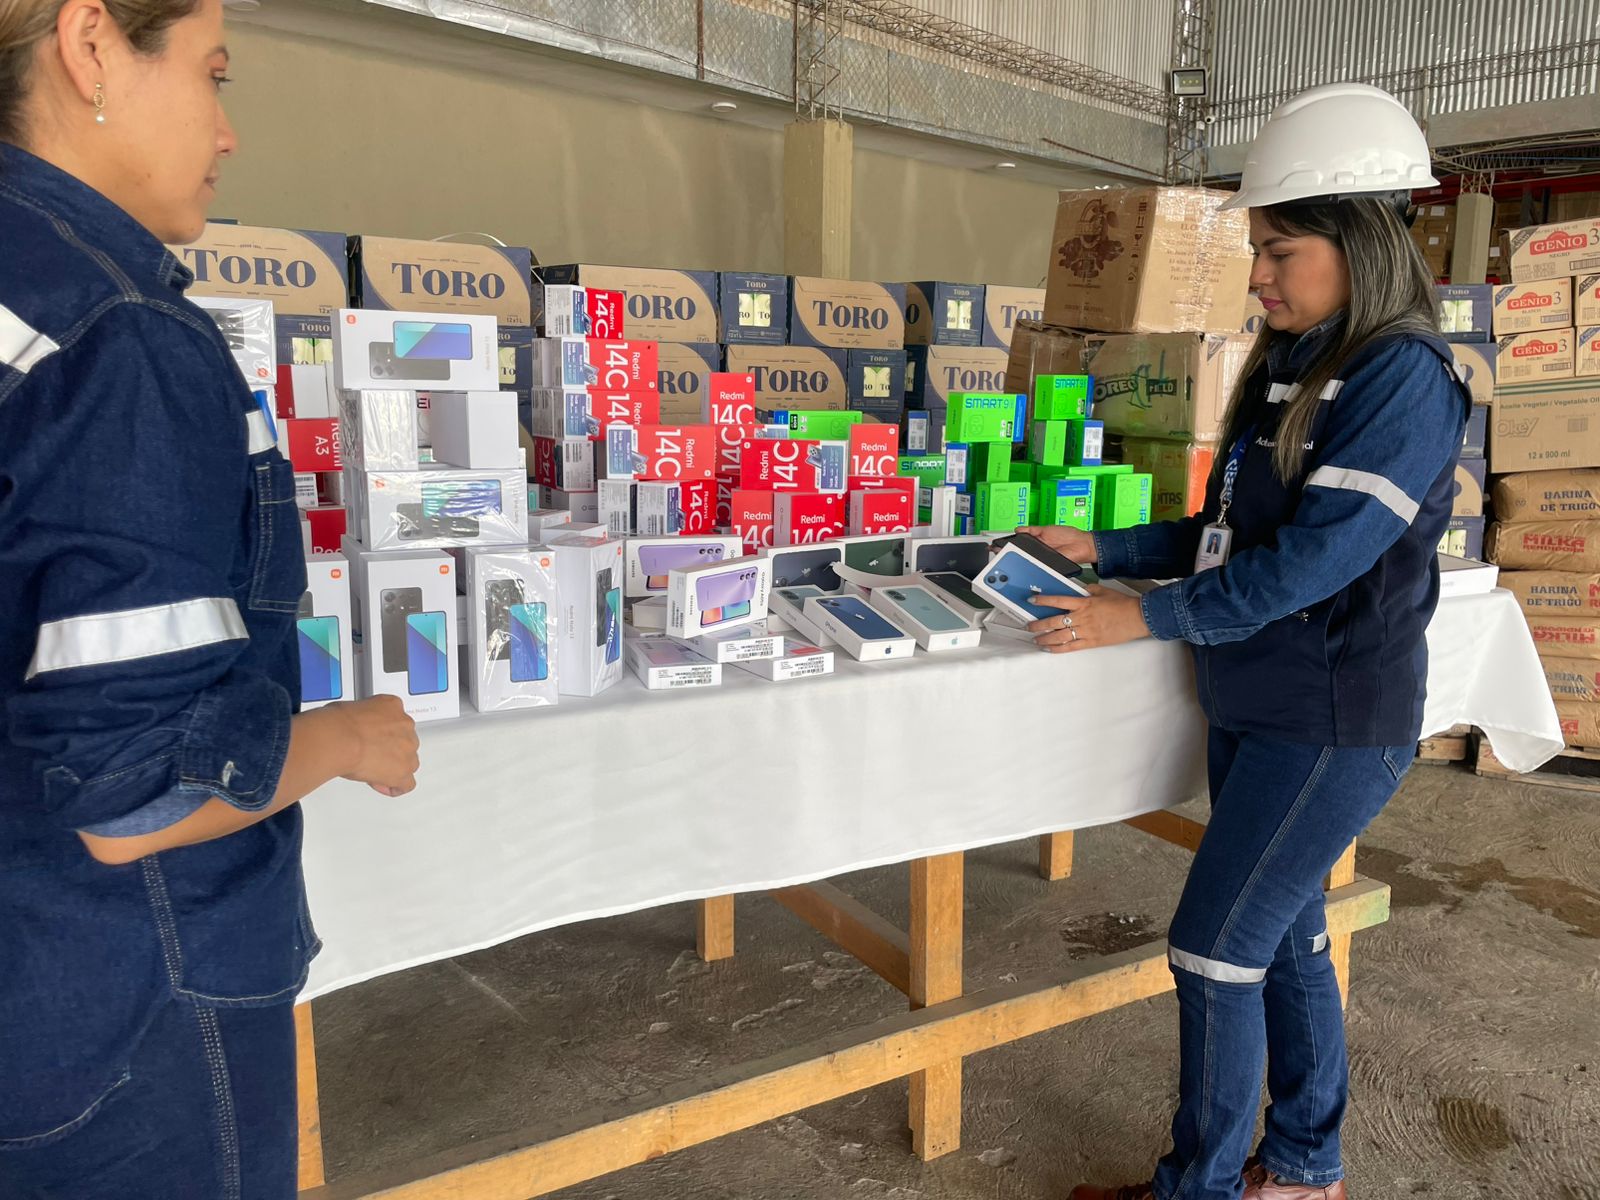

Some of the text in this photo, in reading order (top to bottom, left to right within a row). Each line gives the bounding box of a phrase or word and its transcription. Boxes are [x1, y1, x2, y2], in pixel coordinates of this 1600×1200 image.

[1534, 236, 1583, 252] GENIO
[1589, 228, 1600, 245] 3
[183, 248, 317, 288] TORO
[391, 262, 506, 299] TORO
[745, 280, 767, 289] TORO
[620, 290, 697, 321] ORO
[1510, 291, 1561, 308] GENIO 3
[595, 293, 609, 338] 14C
[739, 311, 750, 319] RO
[812, 299, 889, 330] TORO
[1000, 305, 1044, 329] TO
[298, 322, 331, 332] TORO
[1515, 338, 1567, 355] GENIO 3
[605, 342, 629, 389] 14C
[632, 351, 641, 380] Redmi
[657, 370, 699, 395] RO
[747, 366, 829, 393] TORO
[1055, 378, 1078, 389] SMART
[1093, 379, 1138, 402] OREO
[719, 392, 745, 401] Redmi
[965, 398, 1003, 409] SMART
[1523, 401, 1548, 409] Vegetal
[1554, 399, 1588, 407] Vegetable
[607, 393, 630, 425] 14
[711, 404, 753, 425] 14C
[314, 435, 330, 456] A3
[655, 428, 682, 478] 14C
[685, 438, 695, 468] Redmi
[721, 426, 746, 472] 14C
[860, 443, 888, 452] Redmi
[542, 440, 551, 484] 14C
[760, 450, 769, 480] Redmi
[773, 441, 800, 489] 14C
[852, 455, 897, 477] 14C
[901, 460, 944, 471] SMART
[716, 476, 733, 521] 14C
[1544, 490, 1592, 499] HARINA
[689, 482, 703, 531] 14C
[743, 511, 772, 521] Redmi
[873, 512, 899, 522] Redmi
[1017, 486, 1027, 528] SMA
[1540, 501, 1597, 512] DE TRIGO
[800, 514, 826, 524] Redmi
[734, 525, 774, 549] 14C
[1523, 534, 1585, 547] MILKA
[1531, 586, 1578, 594] HARINA
[1527, 598, 1582, 607] DE TRIGO
[825, 620, 837, 633] iPhone
[1547, 672, 1584, 682] ARINA
